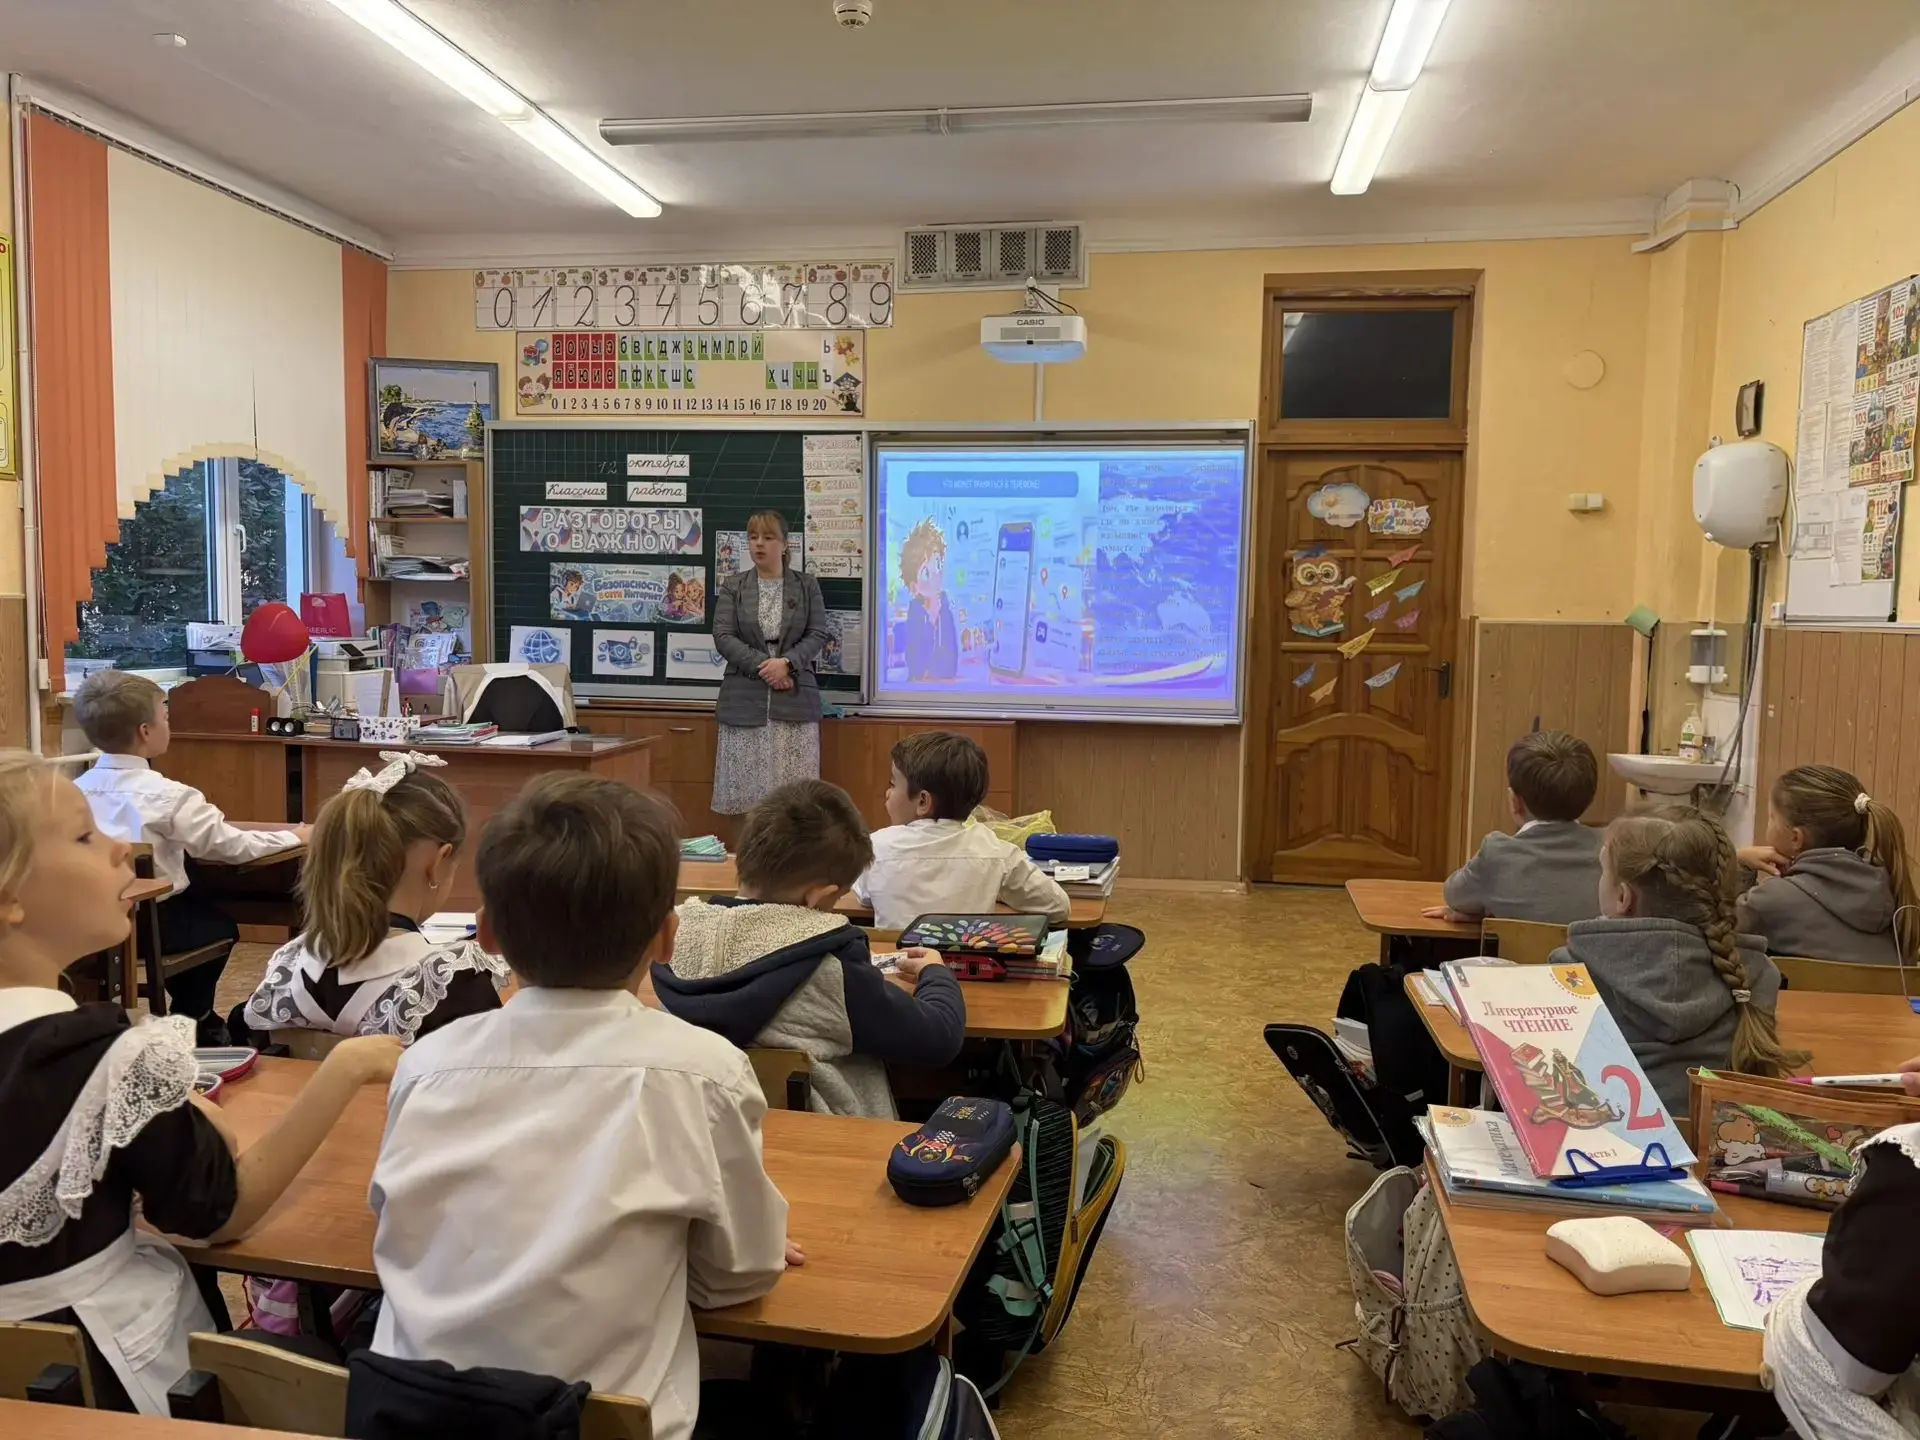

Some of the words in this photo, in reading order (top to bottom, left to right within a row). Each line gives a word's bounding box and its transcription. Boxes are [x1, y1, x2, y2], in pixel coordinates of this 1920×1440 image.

[556, 272, 567, 286] 2
[638, 271, 647, 286] 4
[680, 269, 689, 284] 5
[494, 287, 513, 328] 0
[532, 286, 553, 327] 1
[574, 285, 594, 326] 2
[615, 285, 635, 326] 3
[656, 284, 677, 326] 4
[698, 283, 719, 325] 5
[740, 283, 762, 325] 6
[783, 283, 804, 324] 7
[826, 282, 848, 325] 8
[870, 282, 892, 325] 9
[552, 398, 559, 410] 0
[562, 398, 567, 410] 1
[570, 398, 577, 410] 2
[581, 398, 588, 410] 3
[592, 398, 598, 410] 4
[603, 398, 609, 410] 5
[614, 398, 620, 410] 6
[624, 398, 630, 410] 7
[634, 398, 641, 410] 8
[645, 398, 652, 410] 9
[657, 398, 668, 410] 10
[673, 398, 681, 410] 11
[686, 398, 697, 410] 12
[701, 398, 713, 410] 13
[717, 398, 728, 410] 14
[734, 398, 745, 410] 15
[750, 398, 761, 410] 16
[766, 398, 776, 410] 17
[781, 398, 792, 410] 18
[797, 398, 808, 410] 19
[812, 398, 827, 410] 20
[1855, 411, 1867, 426] 103
[547, 484, 606, 496] Классная
[1875, 499, 1888, 516] 112
[541, 512, 680, 531] РАЗГОВОРЫ
[1384, 515, 1395, 530] 2
[546, 532, 560, 548] О
[570, 532, 677, 550] ВАЖНОМ
[594, 579, 665, 593] Безопасность
[1481, 1000, 1579, 1019] Литературное
[1503, 1019, 1574, 1033] ЧТЕНИЕ
[1600, 1064, 1666, 1131] 2
[1486, 1120, 1519, 1177] Математика
